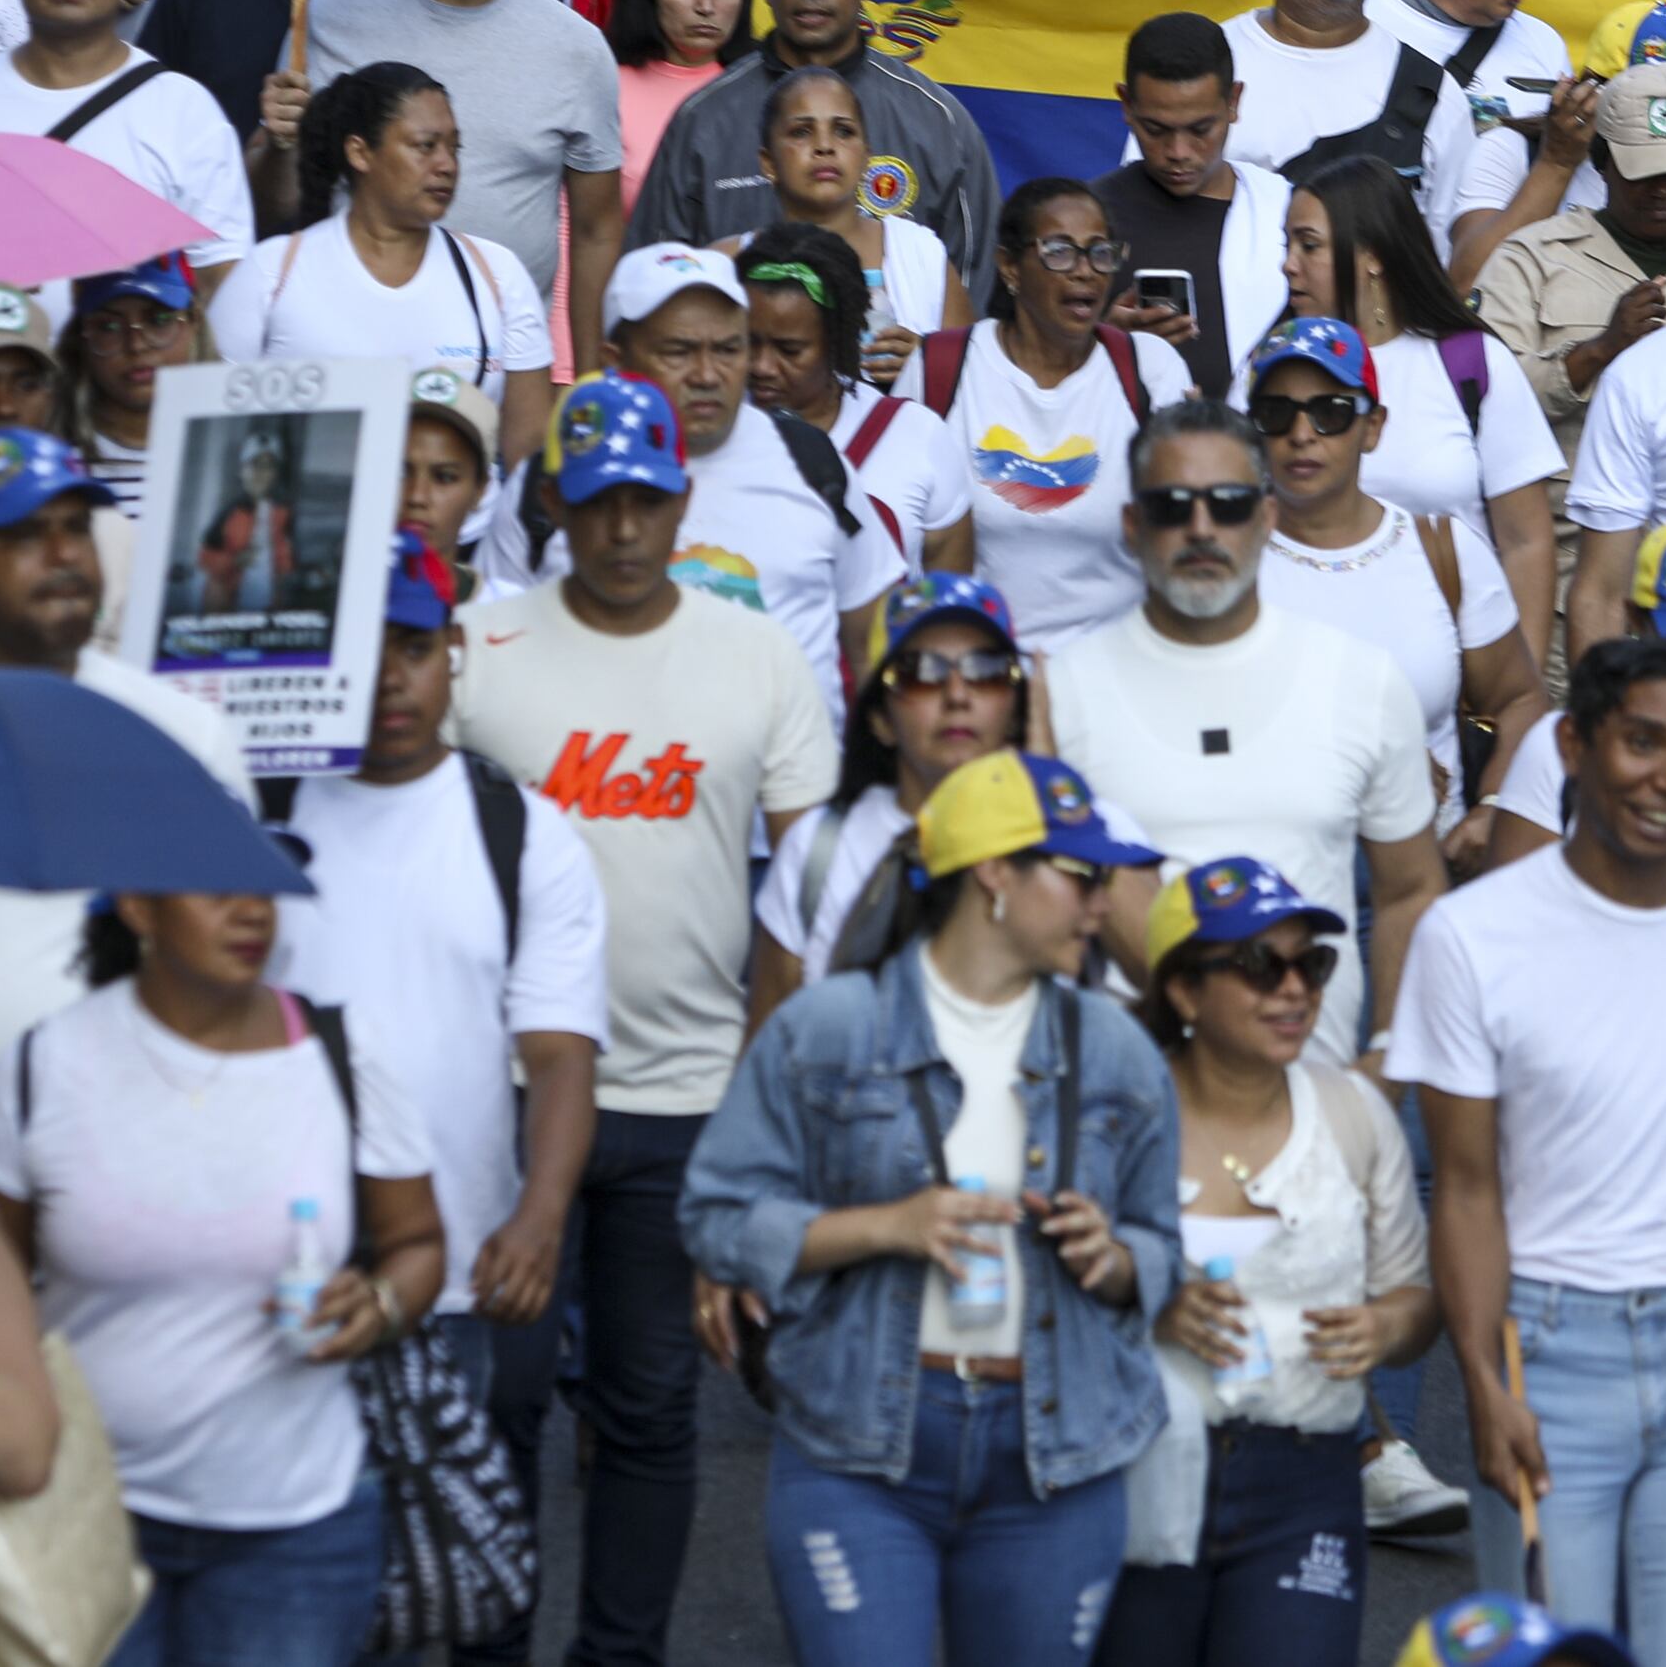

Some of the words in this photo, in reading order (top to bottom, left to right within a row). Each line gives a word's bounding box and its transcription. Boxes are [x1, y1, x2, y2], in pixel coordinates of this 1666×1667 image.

[224, 365, 325, 410] SOS
[227, 675, 325, 693] LIBEREN
[224, 697, 344, 715] NUESTROS
[248, 722, 313, 738] HIJOS
[542, 730, 706, 821] Mets
